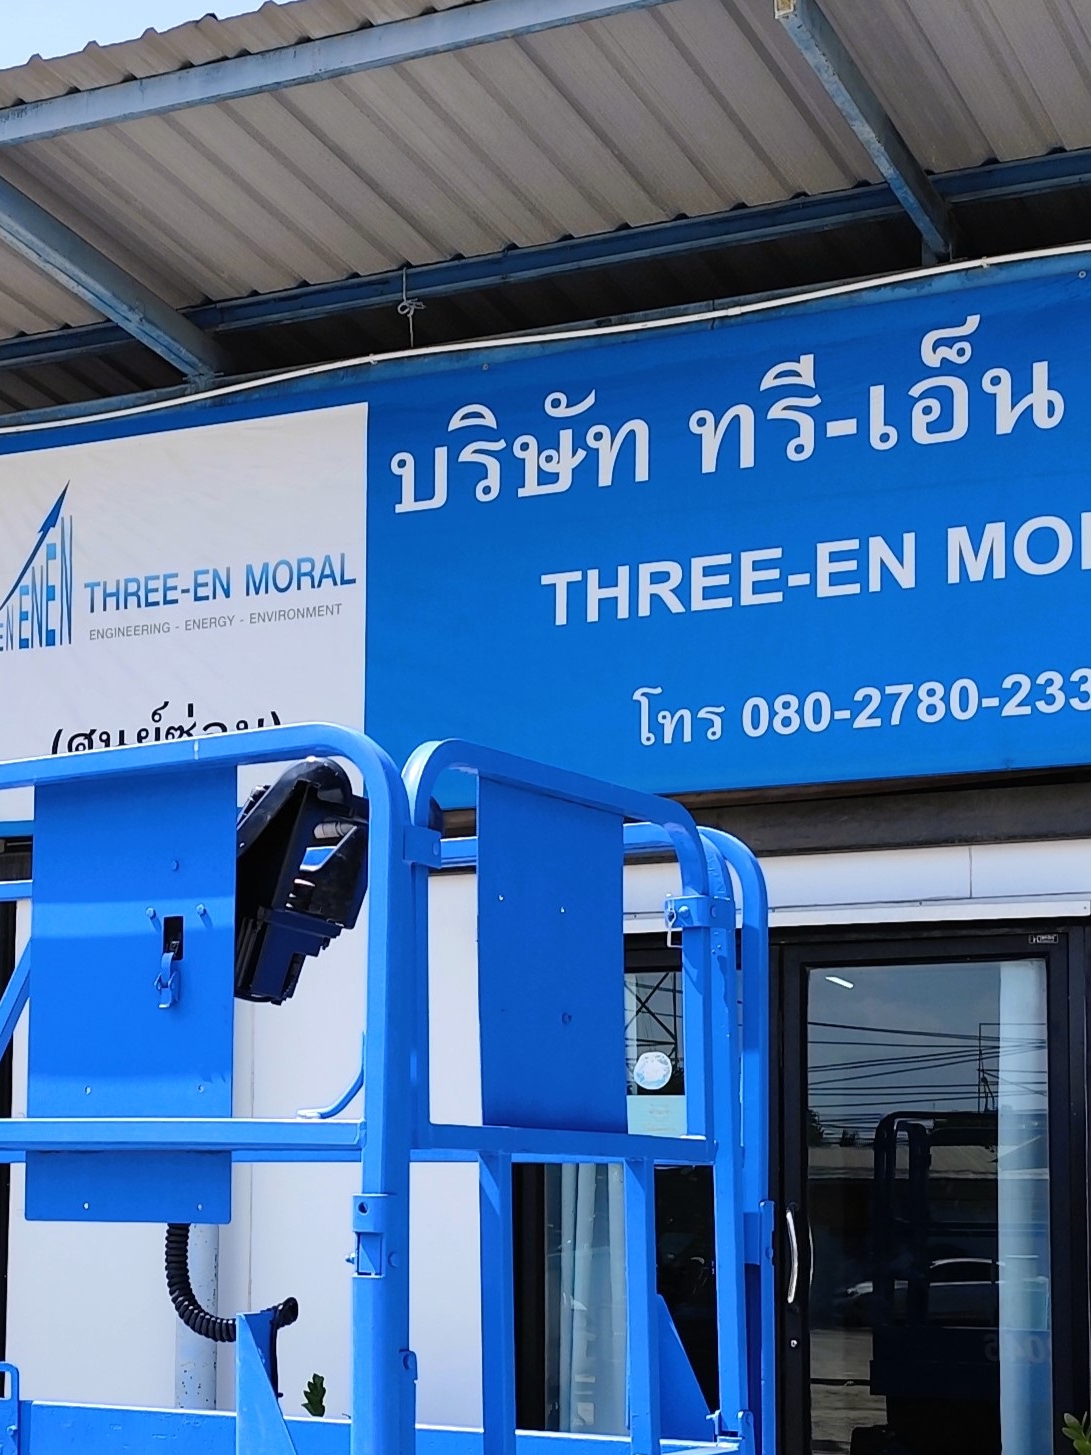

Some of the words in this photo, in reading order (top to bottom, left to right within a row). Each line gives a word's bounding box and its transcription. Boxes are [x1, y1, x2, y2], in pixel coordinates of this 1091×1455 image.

[390, 389, 652, 513] บริษัท
[689, 314, 1064, 474] ทรี-เอ็น
[84, 565, 232, 613] THREE-EN
[245, 553, 357, 597] MORAL
[540, 532, 916, 626] THREE-EN
[946, 511, 1091, 585] MO
[89, 622, 171, 641] ENGINEERING
[184, 615, 236, 632] ENERGY
[249, 603, 343, 625] ENVIRONMENT
[632, 686, 726, 747] โทร
[741, 667, 1091, 738] 080-2780-233
